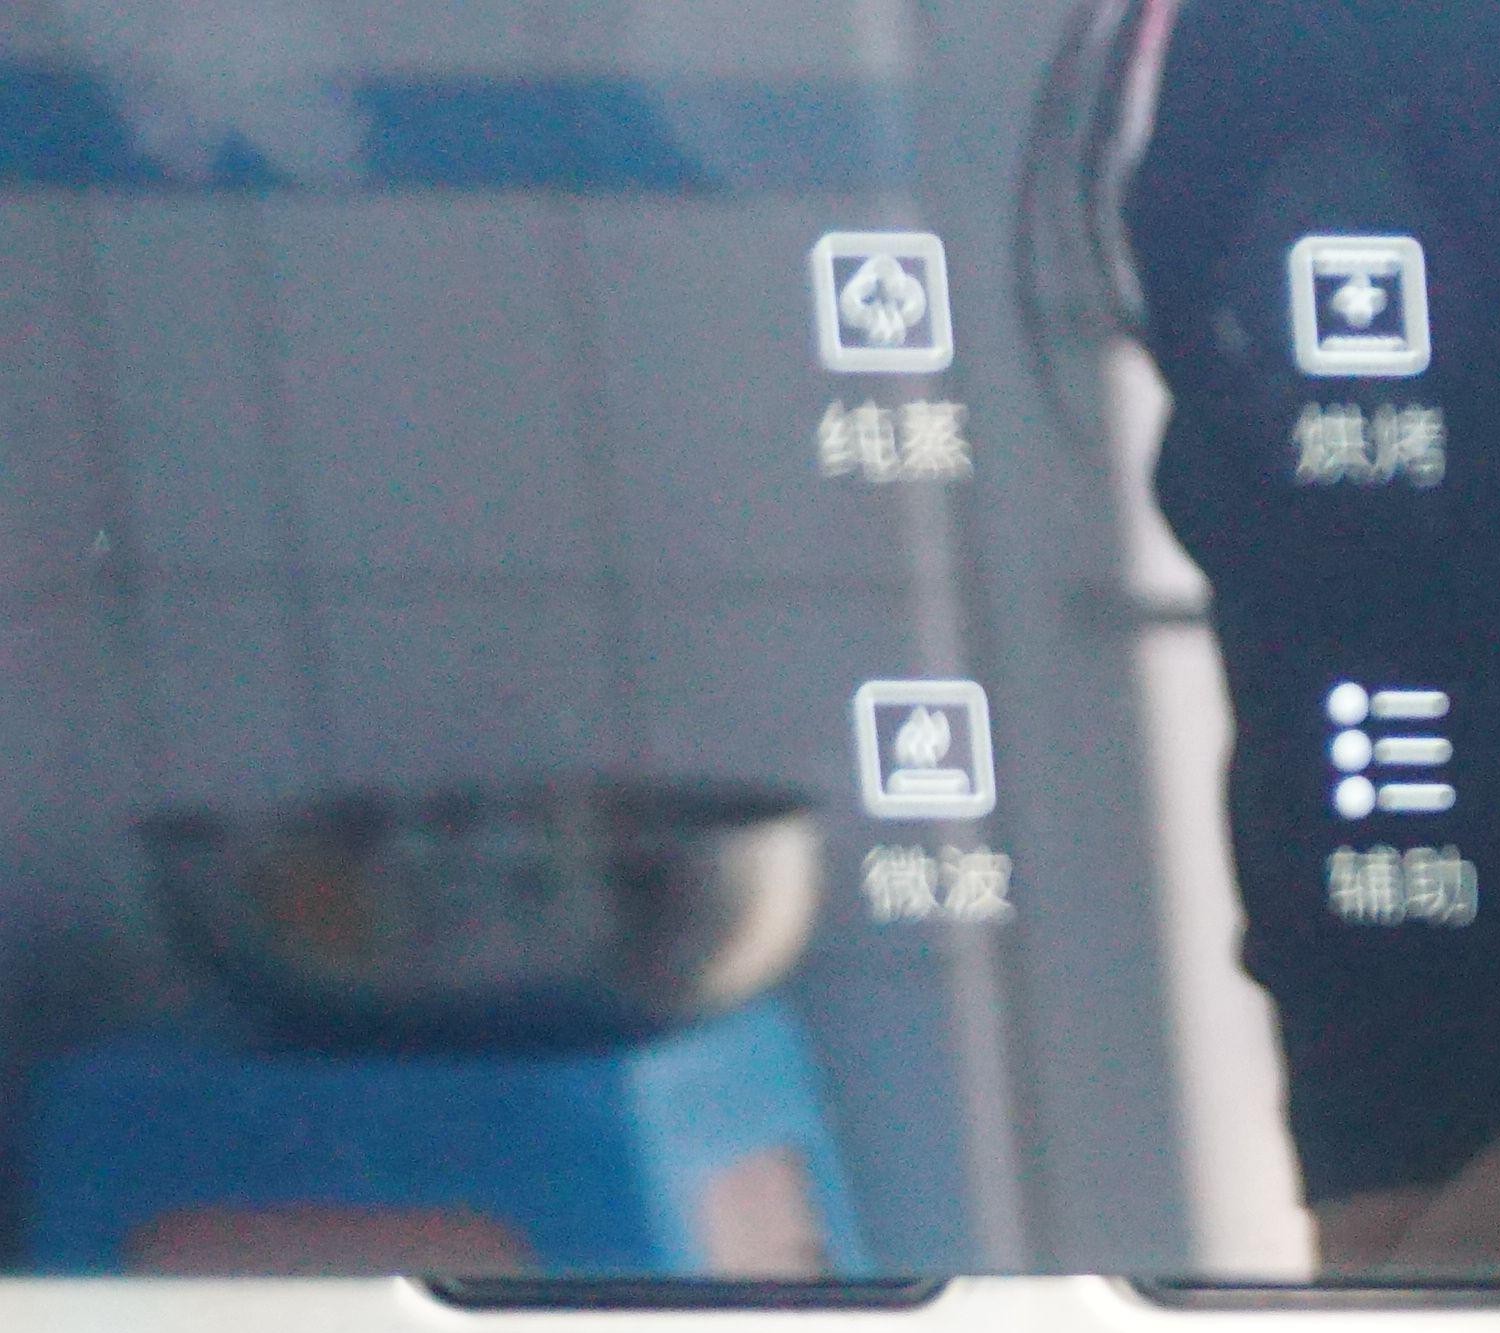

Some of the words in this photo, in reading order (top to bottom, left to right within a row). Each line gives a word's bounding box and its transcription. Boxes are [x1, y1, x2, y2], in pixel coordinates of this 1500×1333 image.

[816, 400, 974, 484] 纯蒸
[861, 843, 1013, 922] 微波
[1326, 843, 1478, 928] 辅助
